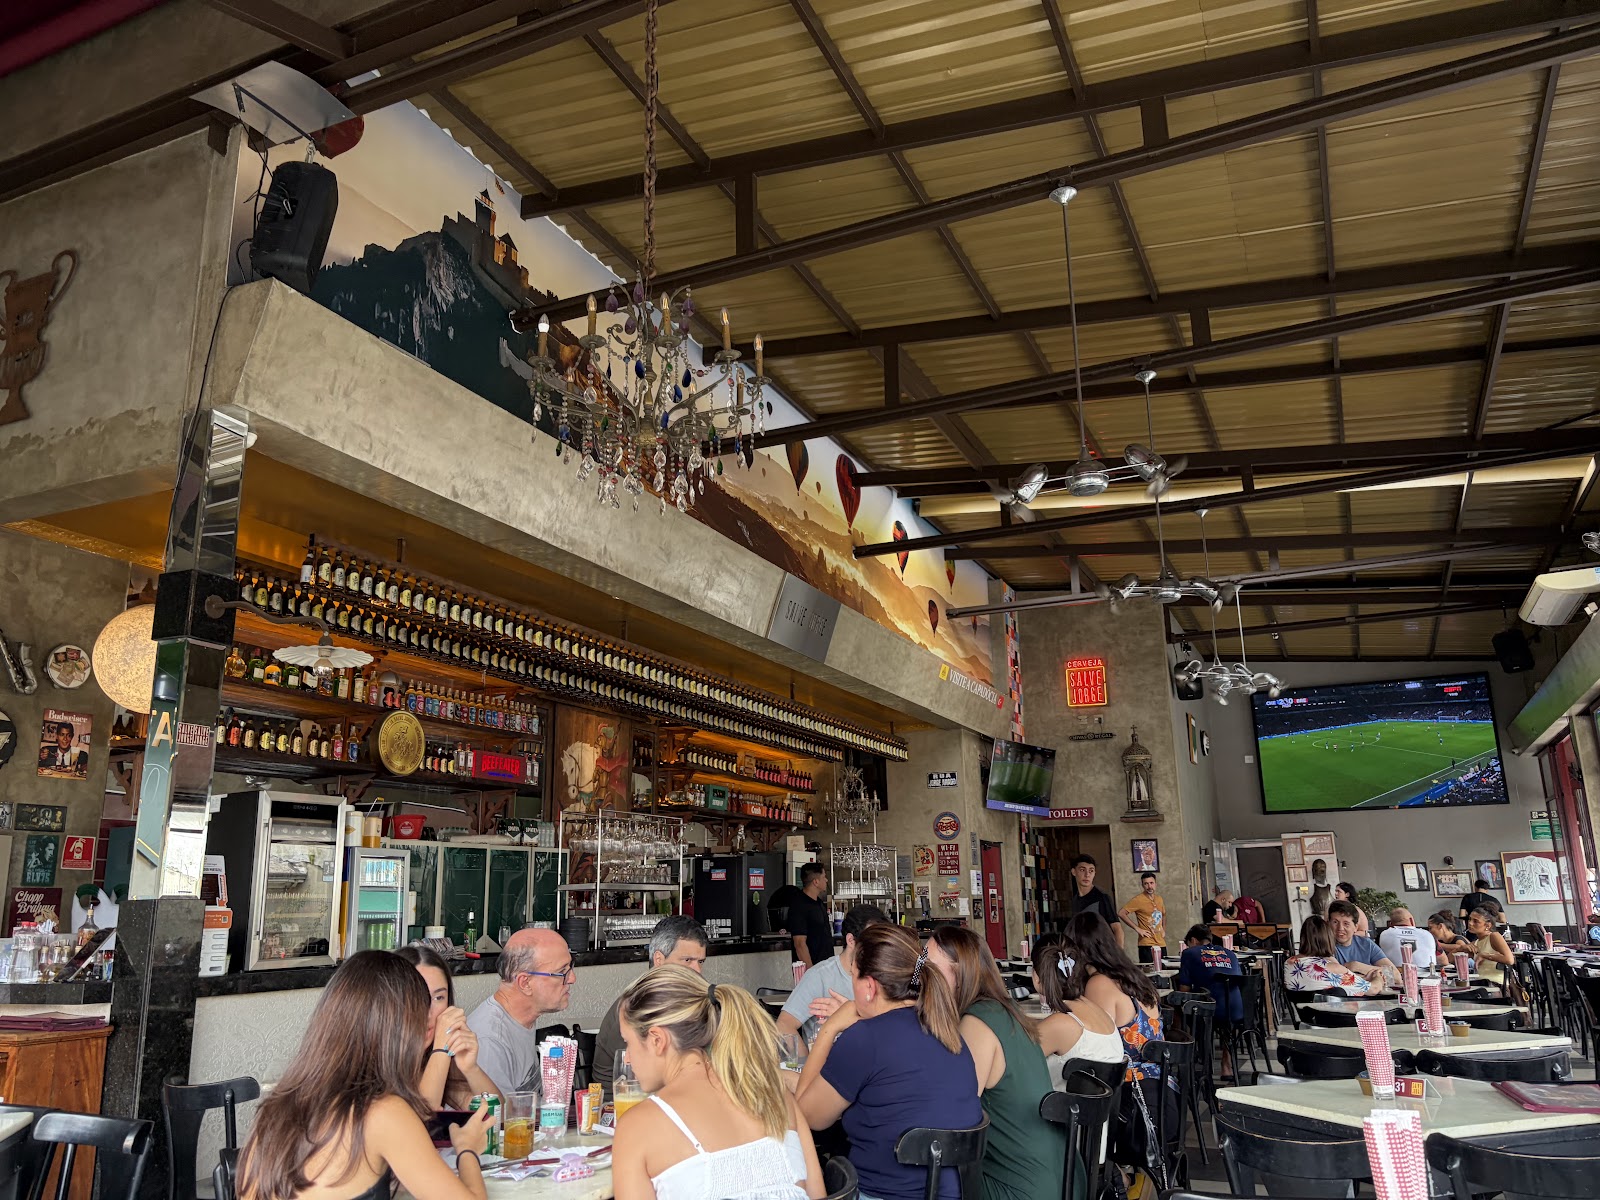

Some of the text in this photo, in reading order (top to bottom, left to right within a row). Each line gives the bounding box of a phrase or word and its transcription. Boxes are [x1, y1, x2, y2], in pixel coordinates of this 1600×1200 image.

[1067, 659, 1103, 669] CERVEJA
[949, 669, 968, 689] VISITE
[965, 679, 971, 691] A
[1069, 670, 1102, 687] SALVE
[1072, 686, 1104, 704] JORGE
[48, 710, 88, 723] Budweiser
[481, 755, 520, 776] BEEFEATER
[1048, 808, 1089, 819] TOILETS
[15, 890, 44, 905] Chopp
[16, 901, 57, 915] Brahma
[1394, 1081, 1406, 1093] 31
